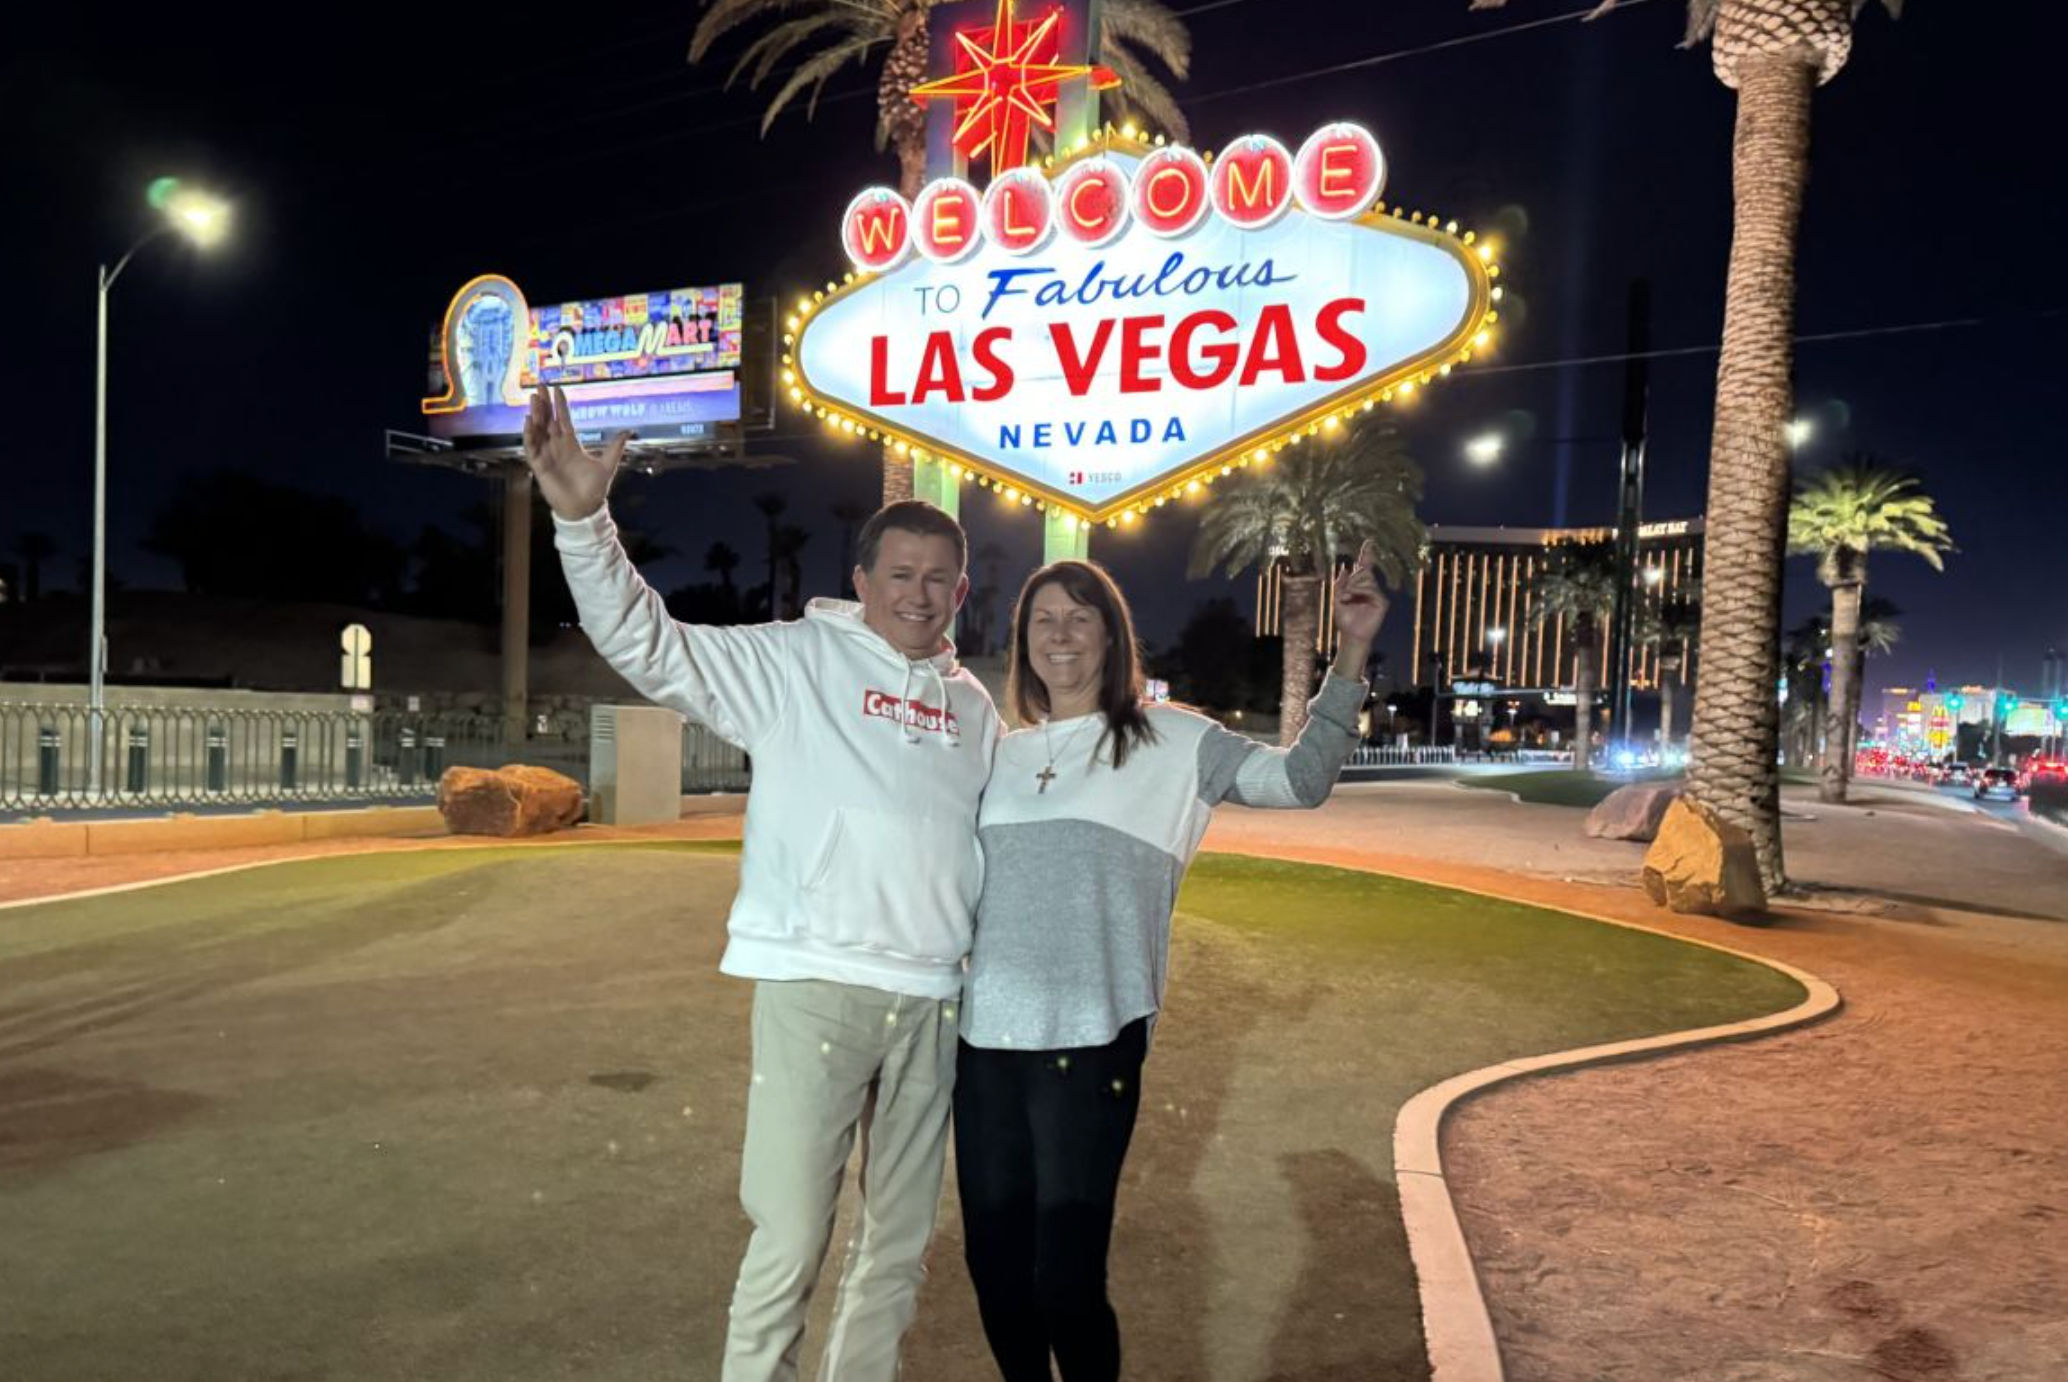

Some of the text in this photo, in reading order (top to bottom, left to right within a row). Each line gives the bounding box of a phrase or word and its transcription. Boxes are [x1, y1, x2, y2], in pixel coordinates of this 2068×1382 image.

[855, 143, 1360, 256] WELCOME
[914, 251, 1298, 320] TO Fabulous
[870, 297, 1367, 407] LAS VEGAS
[999, 416, 1187, 450] NEVADA
